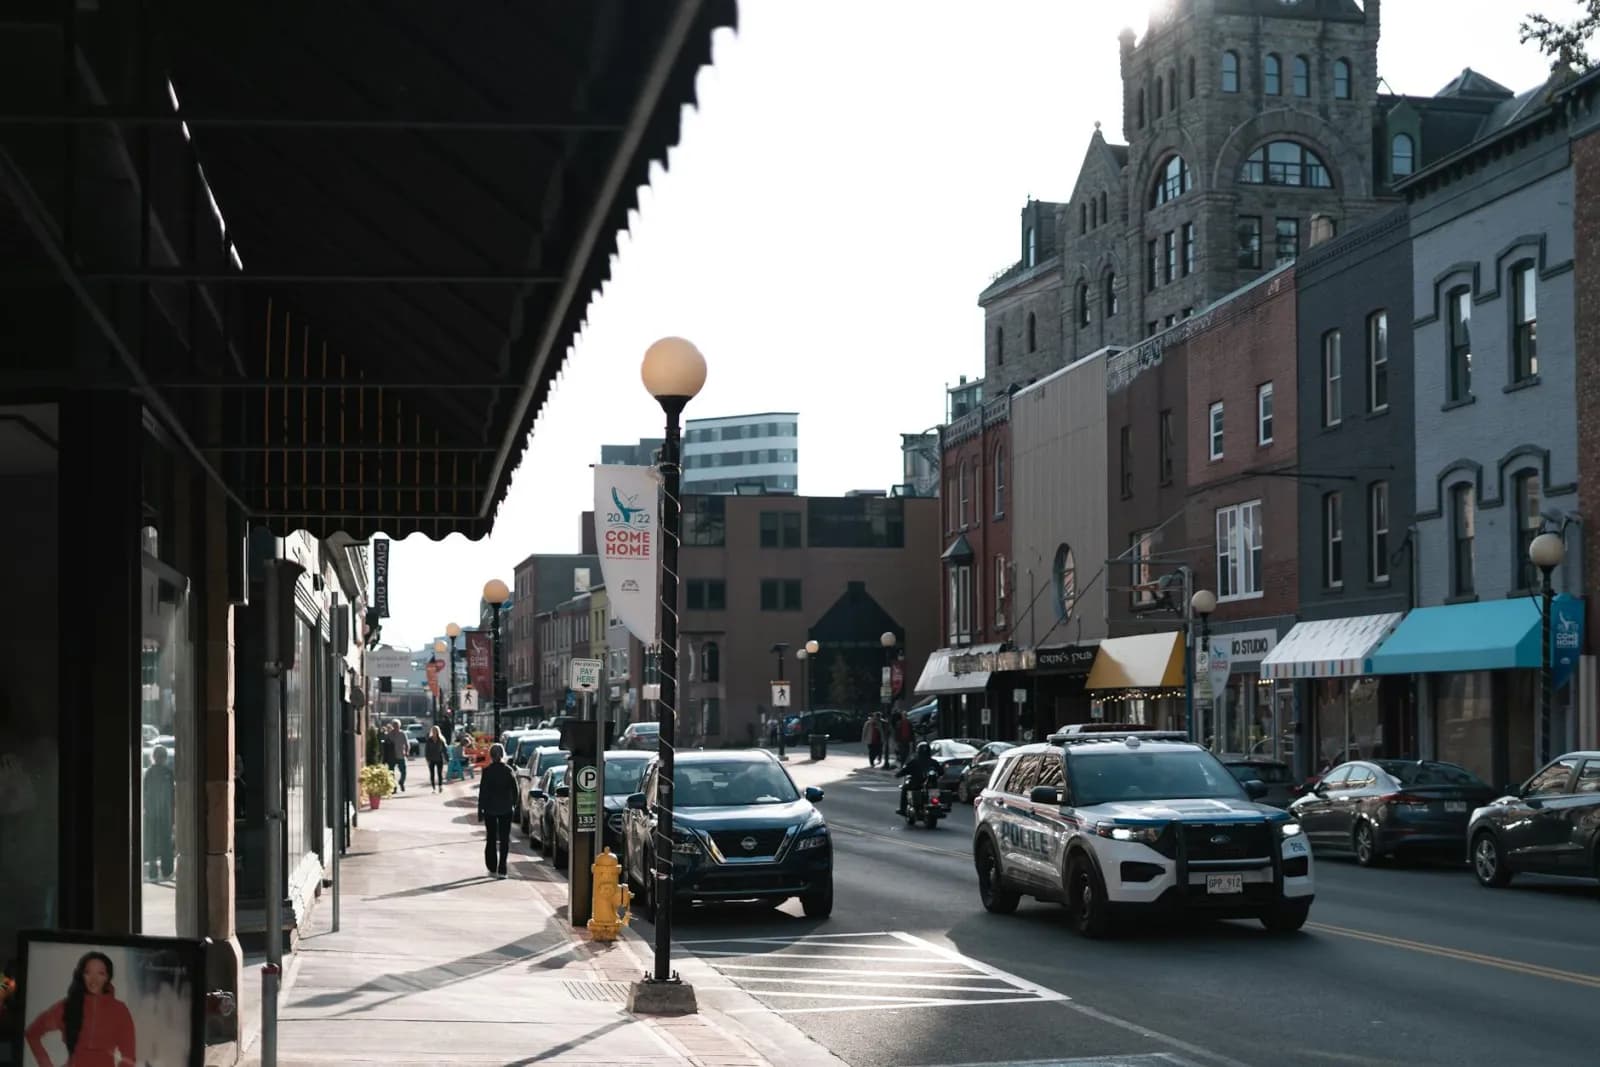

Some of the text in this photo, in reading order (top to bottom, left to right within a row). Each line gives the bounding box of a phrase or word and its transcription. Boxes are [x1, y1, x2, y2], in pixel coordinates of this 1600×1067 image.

[607, 512, 650, 523] 20 22
[605, 530, 650, 544] COME
[605, 543, 650, 556] HOME
[376, 542, 387, 575] CIVIC
[1241, 637, 1268, 655] STUDIO
[580, 667, 594, 675] PAY
[577, 675, 596, 683] HERE
[585, 772, 596, 786] P
[1001, 821, 1049, 855] POLICE
